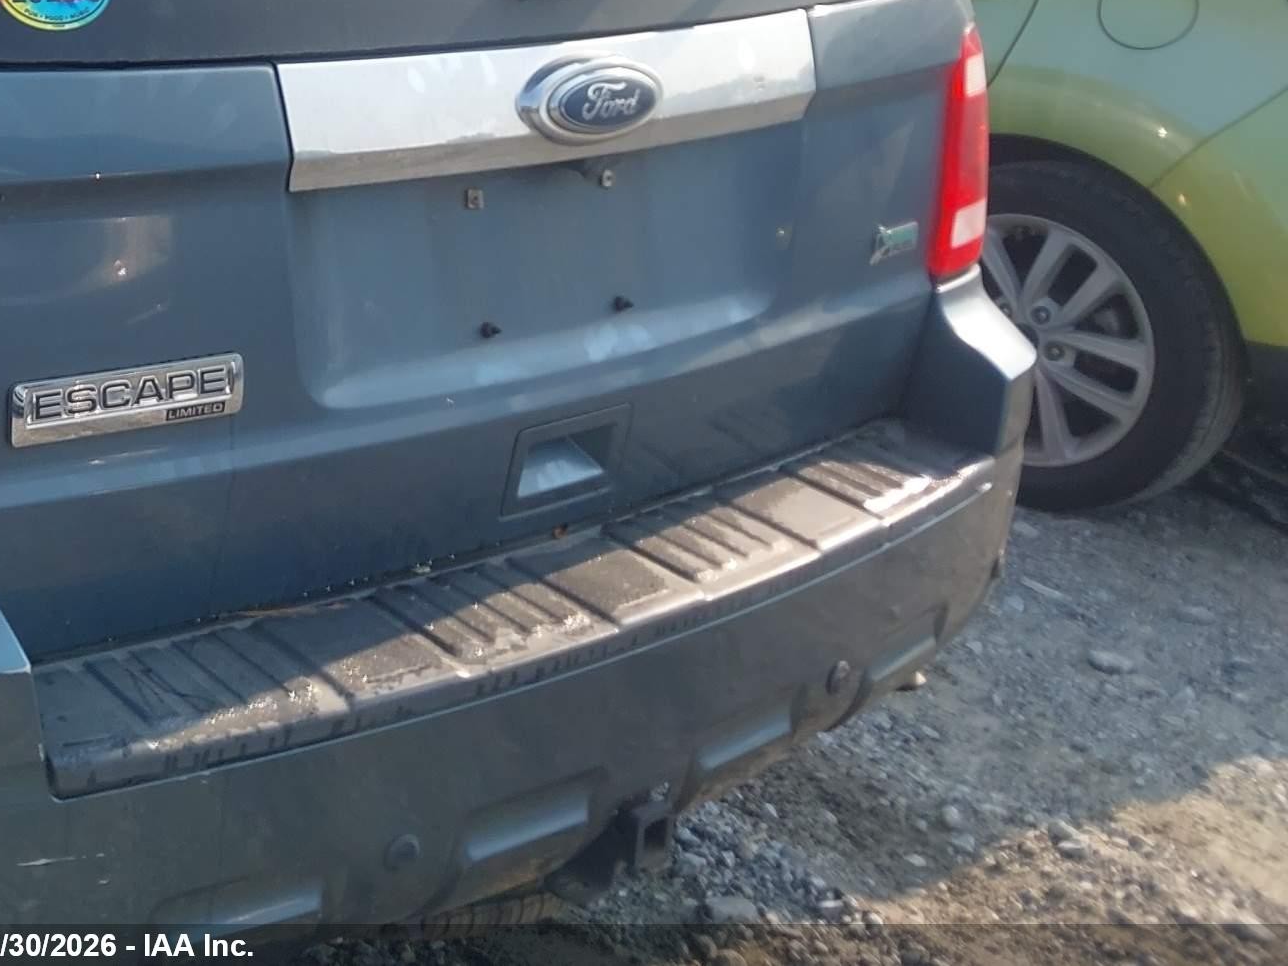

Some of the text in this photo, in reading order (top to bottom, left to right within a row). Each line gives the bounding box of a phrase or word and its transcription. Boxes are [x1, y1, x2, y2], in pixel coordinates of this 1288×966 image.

[581, 81, 641, 121] Ford
[32, 365, 229, 422] ESCAPE
[167, 402, 224, 420] LIMITED
